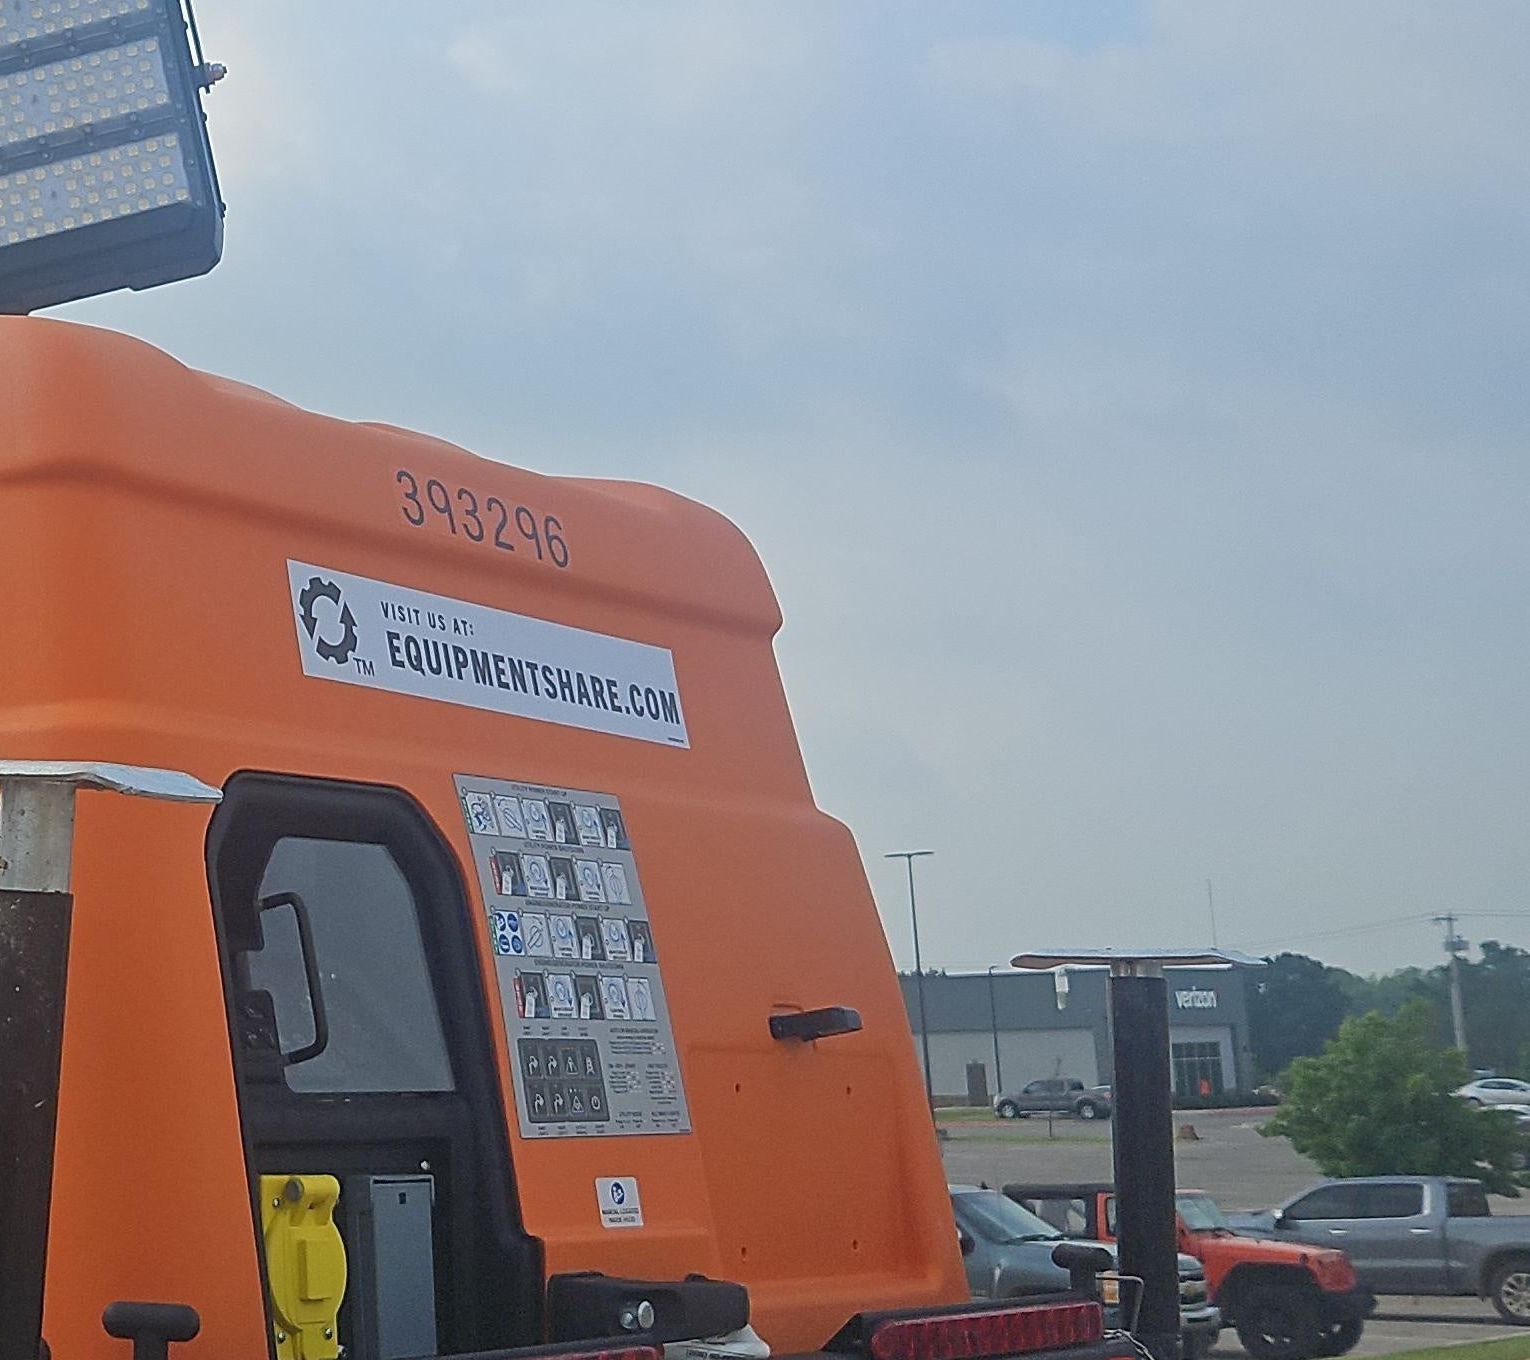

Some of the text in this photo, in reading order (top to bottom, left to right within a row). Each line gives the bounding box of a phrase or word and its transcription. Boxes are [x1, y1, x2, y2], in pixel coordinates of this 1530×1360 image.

[396, 470, 568, 569] 393296
[380, 600, 475, 637] VISIT US AT:
[352, 656, 375, 677] TM
[385, 630, 681, 726] EQUIPMENTSHARE.COM
[1174, 985, 1217, 1009] verizon
